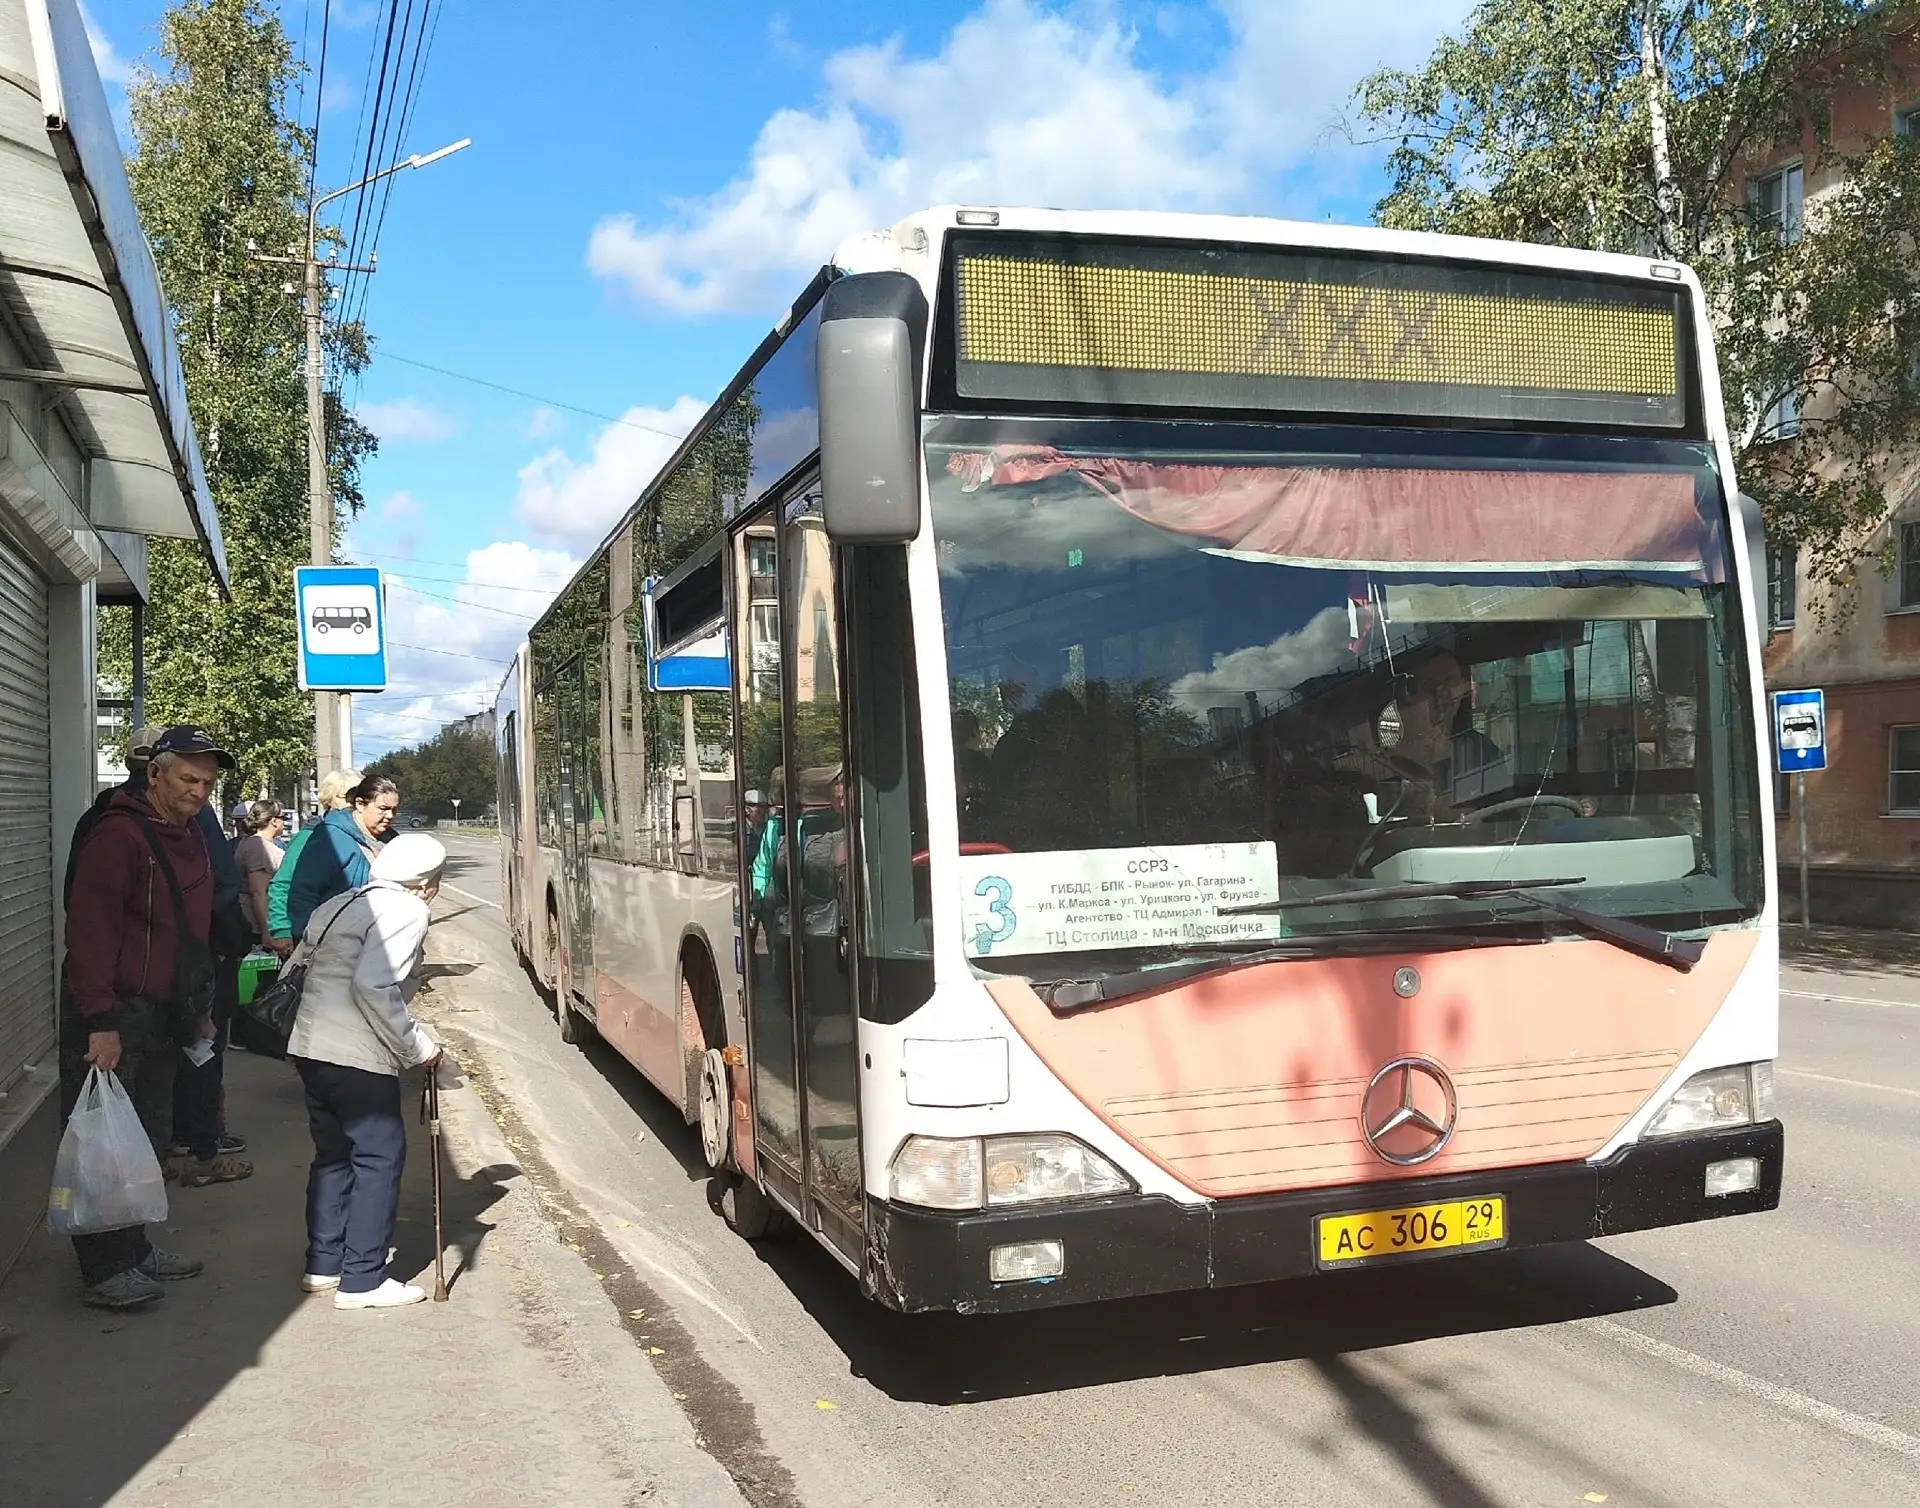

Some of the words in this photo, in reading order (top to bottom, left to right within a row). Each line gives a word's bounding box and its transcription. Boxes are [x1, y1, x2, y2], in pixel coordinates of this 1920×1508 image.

[1127, 859, 1169, 874] ССРЗ
[1050, 883, 1092, 895] ГИБДД
[1101, 880, 1125, 892] БПК
[1178, 880, 1194, 889] ул.
[1197, 876, 1246, 887] Гагарина
[975, 875, 1017, 943] 3
[1038, 902, 1055, 912] ул.
[1058, 898, 1111, 909] К.Маркса
[1120, 897, 1137, 907] ул.
[1140, 894, 1191, 906] Урицкого
[1200, 892, 1217, 902] ул.
[1220, 890, 1260, 901] Фрунзе
[1065, 913, 1123, 924] Агентство
[1133, 909, 1149, 920] ТЦ
[1152, 908, 1202, 919] Адмирал
[1046, 931, 1067, 946] ТЦ
[1072, 929, 1138, 943] Столица
[1183, 922, 1264, 938] Москвичка
[1337, 1226, 1375, 1254] АС
[1391, 1210, 1448, 1247] 306
[1466, 1203, 1493, 1229] 29
[1469, 1230, 1490, 1240] RUS
